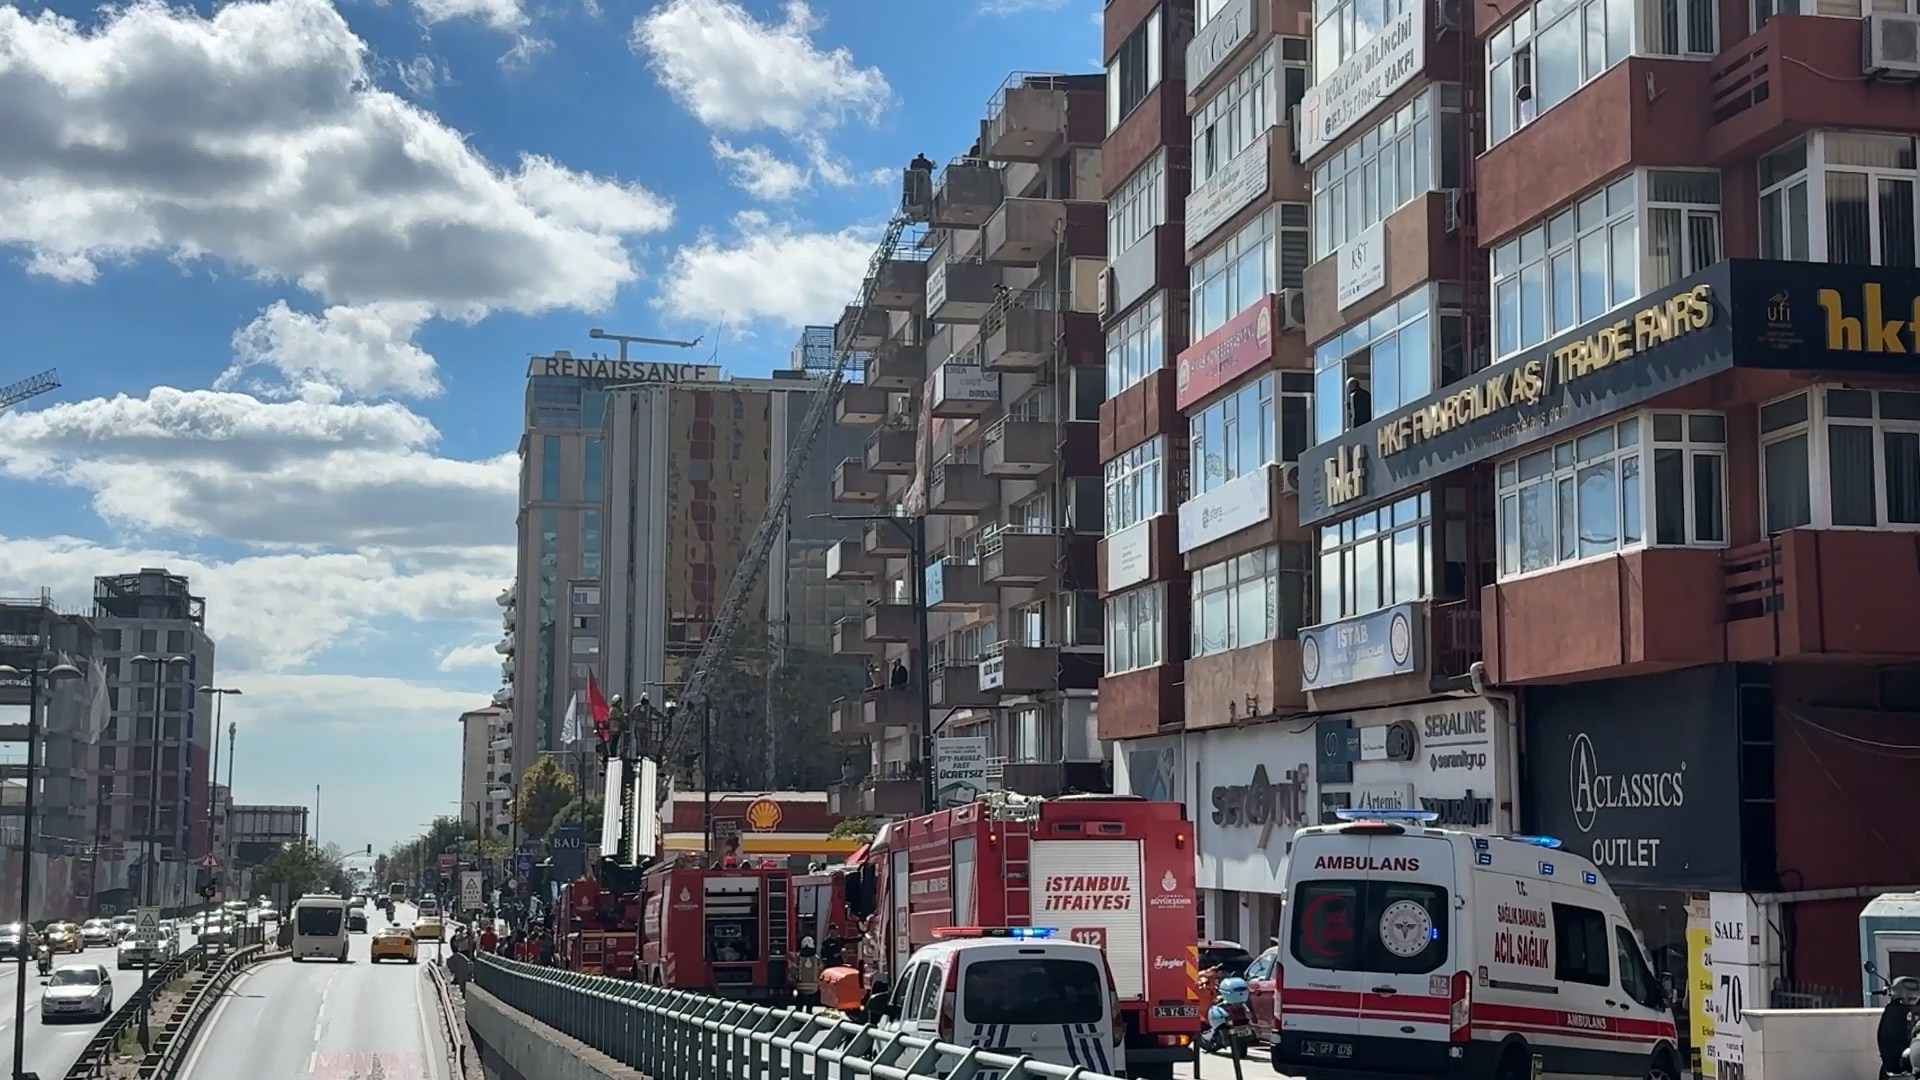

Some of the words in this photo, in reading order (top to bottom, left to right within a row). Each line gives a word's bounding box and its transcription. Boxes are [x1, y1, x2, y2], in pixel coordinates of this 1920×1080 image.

[1767, 303, 1790, 321] ufi
[545, 358, 708, 382] RENAISSANCE
[1377, 416, 1412, 459] HKF
[1511, 360, 1543, 405] AŞ
[1554, 319, 1633, 385] TRADE
[1635, 284, 1713, 353] FAIRS
[1425, 709, 1487, 738] SERALINE
[554, 838, 580, 848] BAU
[1592, 838, 1660, 867] OUTLET
[1314, 855, 1421, 872] AMBULANS
[1076, 931, 1101, 946] 112
[1714, 921, 1745, 941] SALE
[1494, 926, 1515, 964] ACİL
[1516, 930, 1549, 969] SAĞLIK
[1432, 975, 1447, 987] 112
